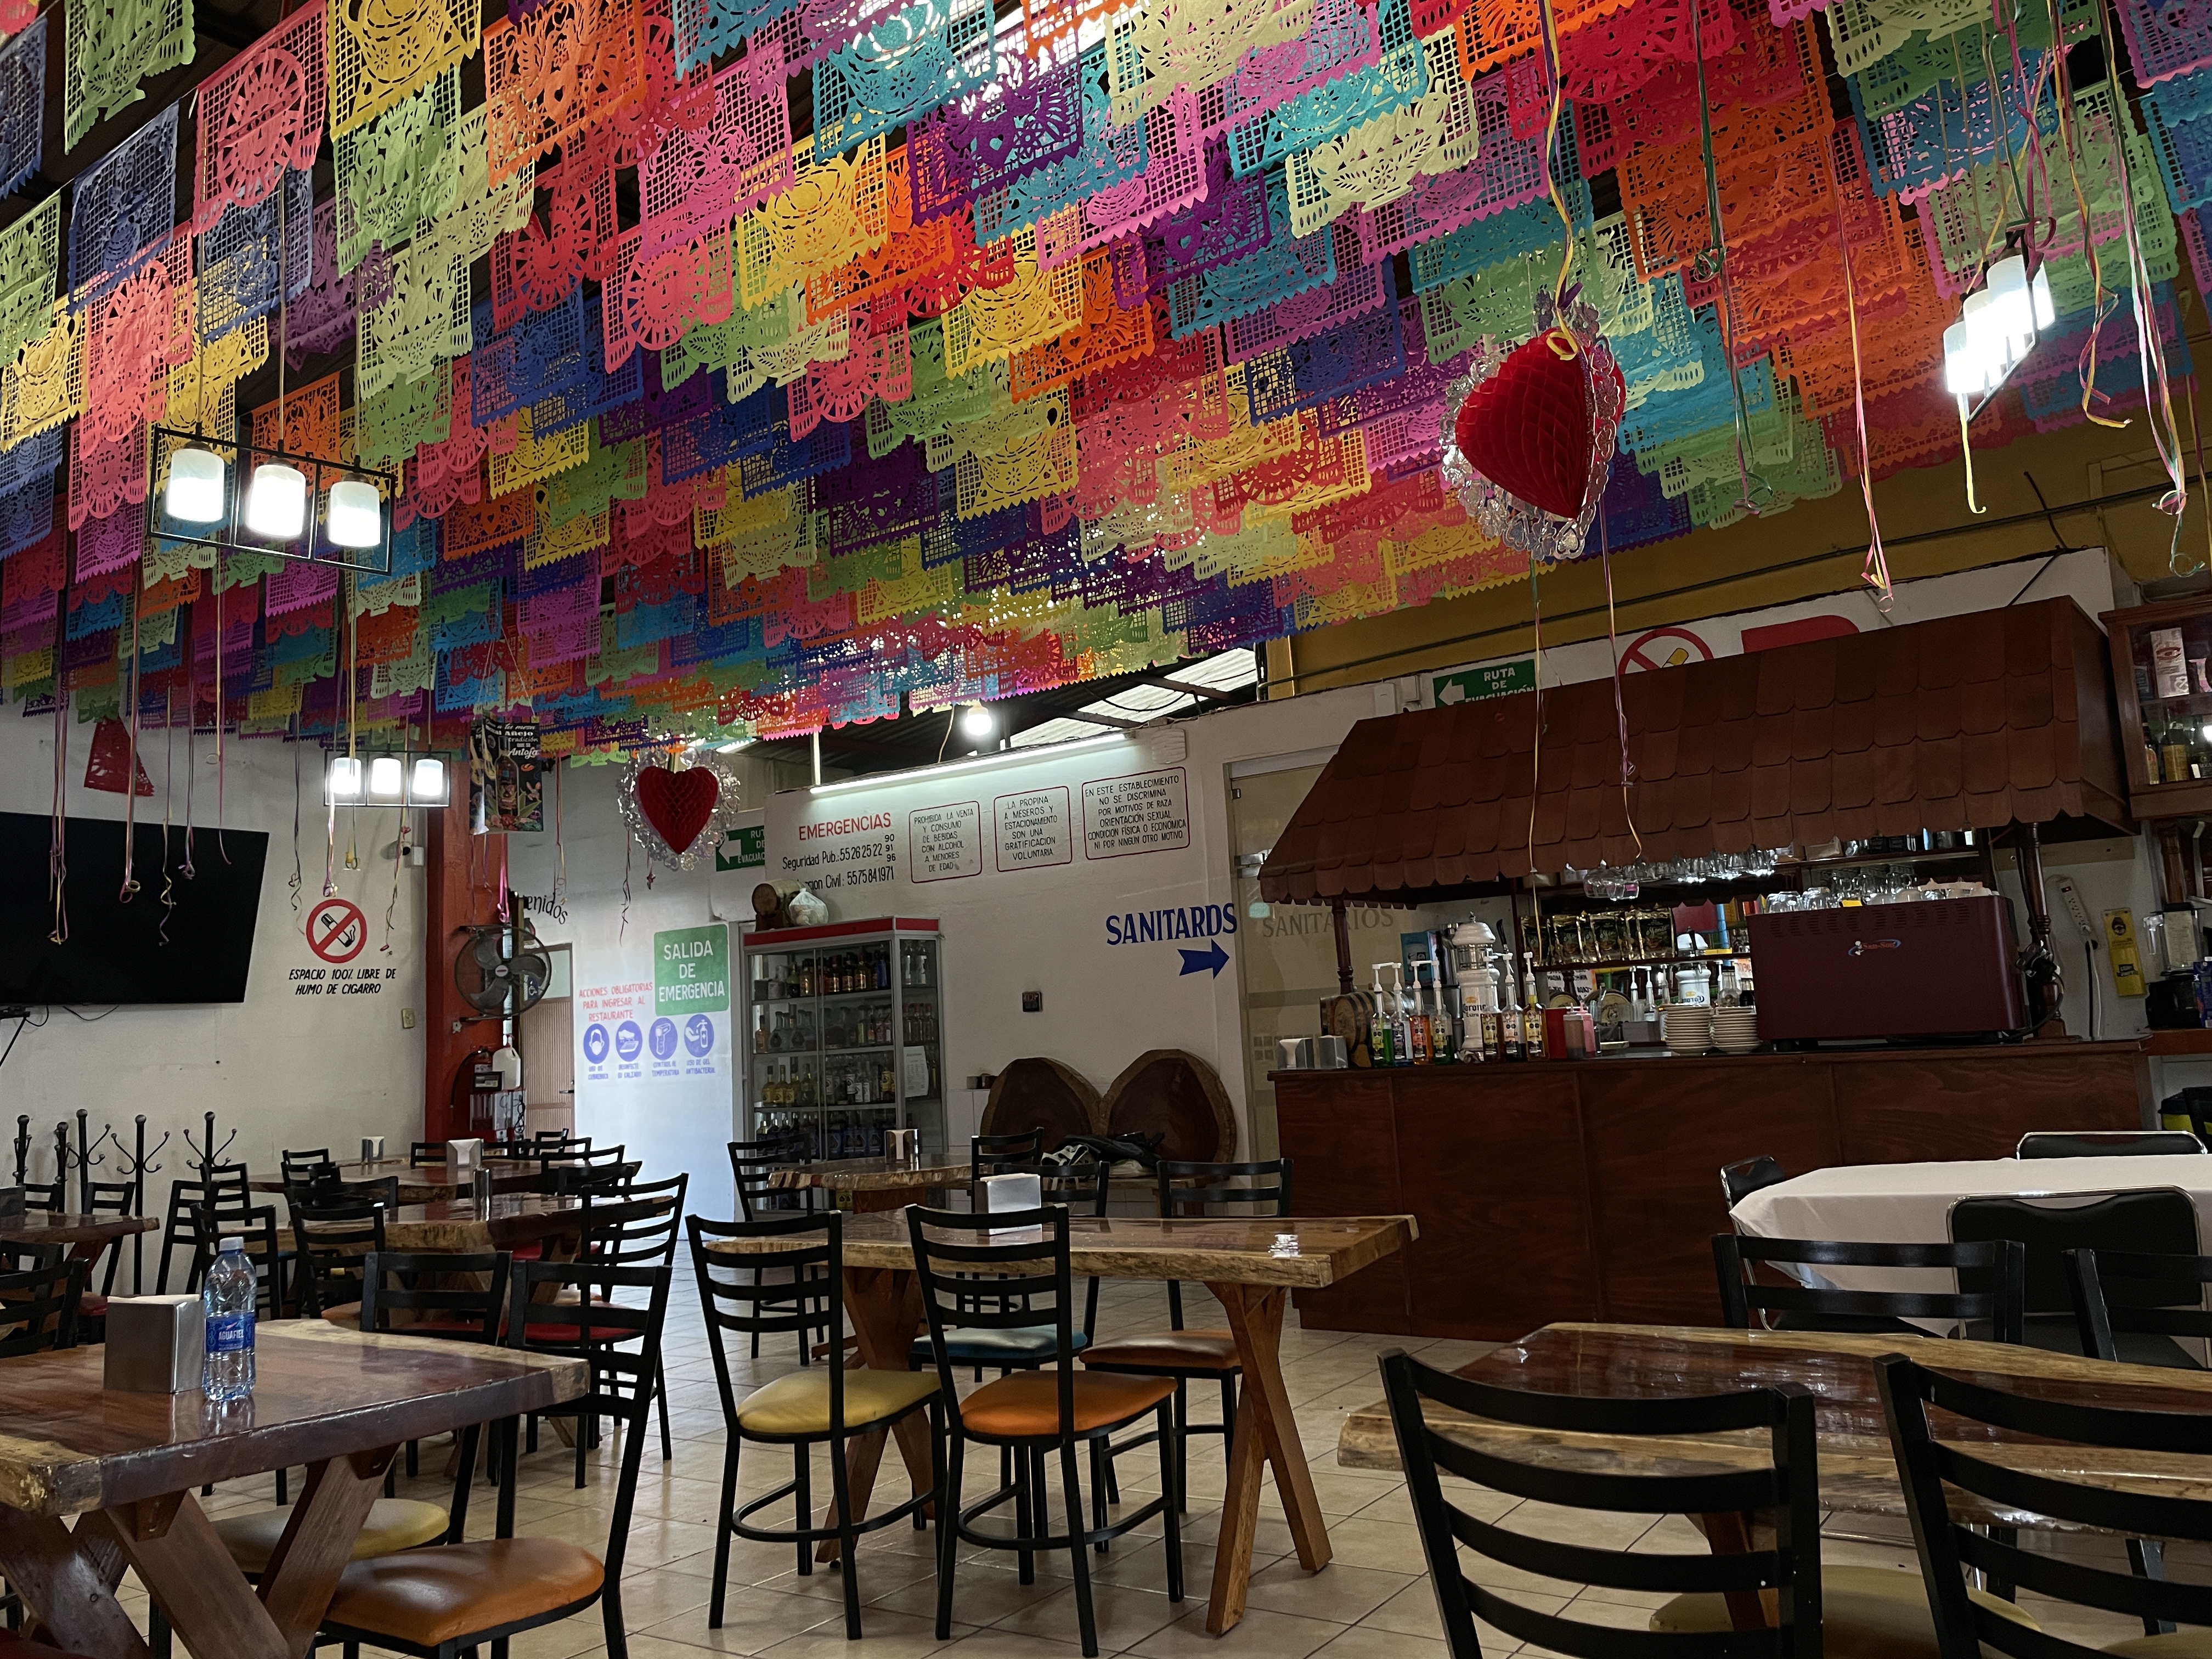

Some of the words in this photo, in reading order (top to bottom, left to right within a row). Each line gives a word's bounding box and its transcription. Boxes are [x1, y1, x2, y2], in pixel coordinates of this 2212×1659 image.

[1484, 667, 1515, 681] RUTA
[1492, 680, 1507, 690] DE
[507, 747, 538, 759] Antoja
[1085, 788, 1094, 797] EN
[1097, 785, 1114, 795] ESTE
[1119, 775, 1179, 792] ESTABLECIMIENTO
[1007, 801, 1016, 810] LA
[1019, 795, 1048, 808] PROPINA
[1099, 797, 1109, 805] NO
[1113, 795, 1122, 804] SE
[1127, 788, 1166, 802] DISCRIMINA
[1005, 812, 1008, 820] A
[1013, 806, 1045, 819] MESEROS
[1049, 805, 1053, 813] Y
[1098, 808, 1111, 816] POR
[1115, 803, 1143, 814] MOTIVOS
[1147, 801, 1154, 809] DE
[914, 814, 942, 825] PROHIBIDA
[946, 811, 953, 820] LA
[956, 808, 974, 819] VENTA
[1005, 815, 1057, 831] ESTACIONAMIENTO
[799, 812, 891, 840] EMERGENCIAS
[931, 820, 962, 832] CONSUMO
[1143, 824, 1148, 833] O
[885, 833, 895, 842] 90
[923, 835, 930, 843] DE
[934, 831, 958, 842] BEBIDAS
[1012, 830, 1026, 839] SON
[1030, 828, 1043, 837] UNA
[922, 845, 935, 853] CON
[938, 840, 964, 851] ALCOHOL
[1094, 842, 1101, 850] NI
[1103, 839, 1115, 848] POR
[1143, 834, 1158, 843] OTRO
[887, 853, 896, 862] 96
[932, 851, 960, 861] MENORES
[1012, 848, 1054, 861] VOLUNTARIA
[782, 853, 819, 871] Seguridad
[929, 864, 935, 872] DE
[939, 862, 954, 871] EDAD
[663, 940, 713, 960] SALIDA
[289, 969, 326, 980] ESPACIO
[331, 968, 354, 980] 100%
[357, 968, 381, 979] LIBRE
[386, 968, 397, 979] DE
[679, 963, 696, 979] DE
[295, 984, 323, 995] HUMO
[326, 984, 338, 995] DE
[342, 983, 381, 995] CIGARRO
[579, 987, 608, 998] ACCIONES
[611, 982, 653, 995] OBLIGATORIAS
[659, 980, 725, 1002] EMERGENCIA
[583, 1000, 599, 1009] PARA
[602, 997, 633, 1008] INGRESAR
[637, 996, 646, 1005] AL
[589, 1009, 634, 1022] RESTAURANTE
[218, 1329, 244, 1340] AGUAFIEL
